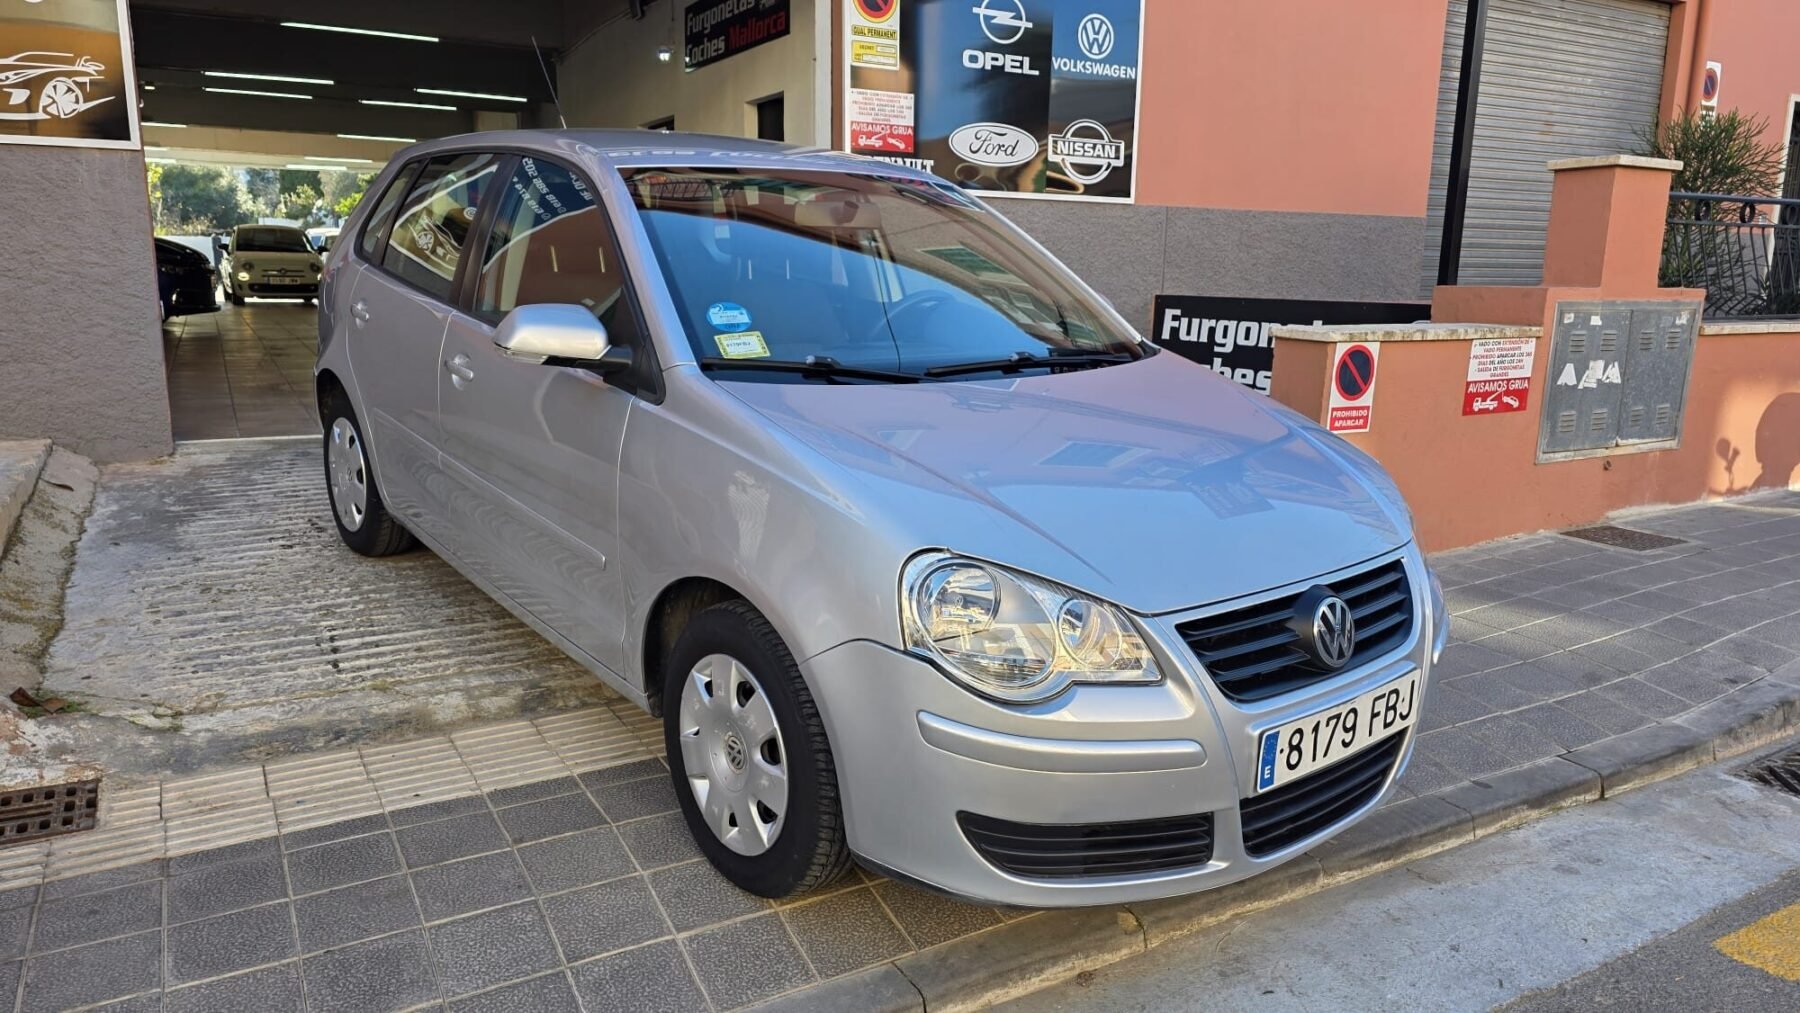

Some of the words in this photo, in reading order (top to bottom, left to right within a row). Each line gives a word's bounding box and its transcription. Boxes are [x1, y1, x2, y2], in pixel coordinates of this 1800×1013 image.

[729, 11, 785, 50] Mallorca
[962, 49, 1040, 76] OPEL
[1052, 56, 1137, 80] VOLKSWAGEN
[851, 122, 891, 134] AVISAMOS
[892, 125, 914, 136] GRUA
[969, 129, 1020, 157] Ford
[1057, 141, 1116, 159] NISSAN
[1161, 308, 1276, 353] Furgon
[1467, 379, 1508, 394] AVISAMOS
[1508, 378, 1529, 391] GRUA
[1332, 409, 1369, 419] PROHIBIDO
[1333, 418, 1365, 428] APARCAR
[1286, 707, 1359, 771] 8179
[1368, 679, 1416, 738] FBJ
[1263, 765, 1272, 779] E
